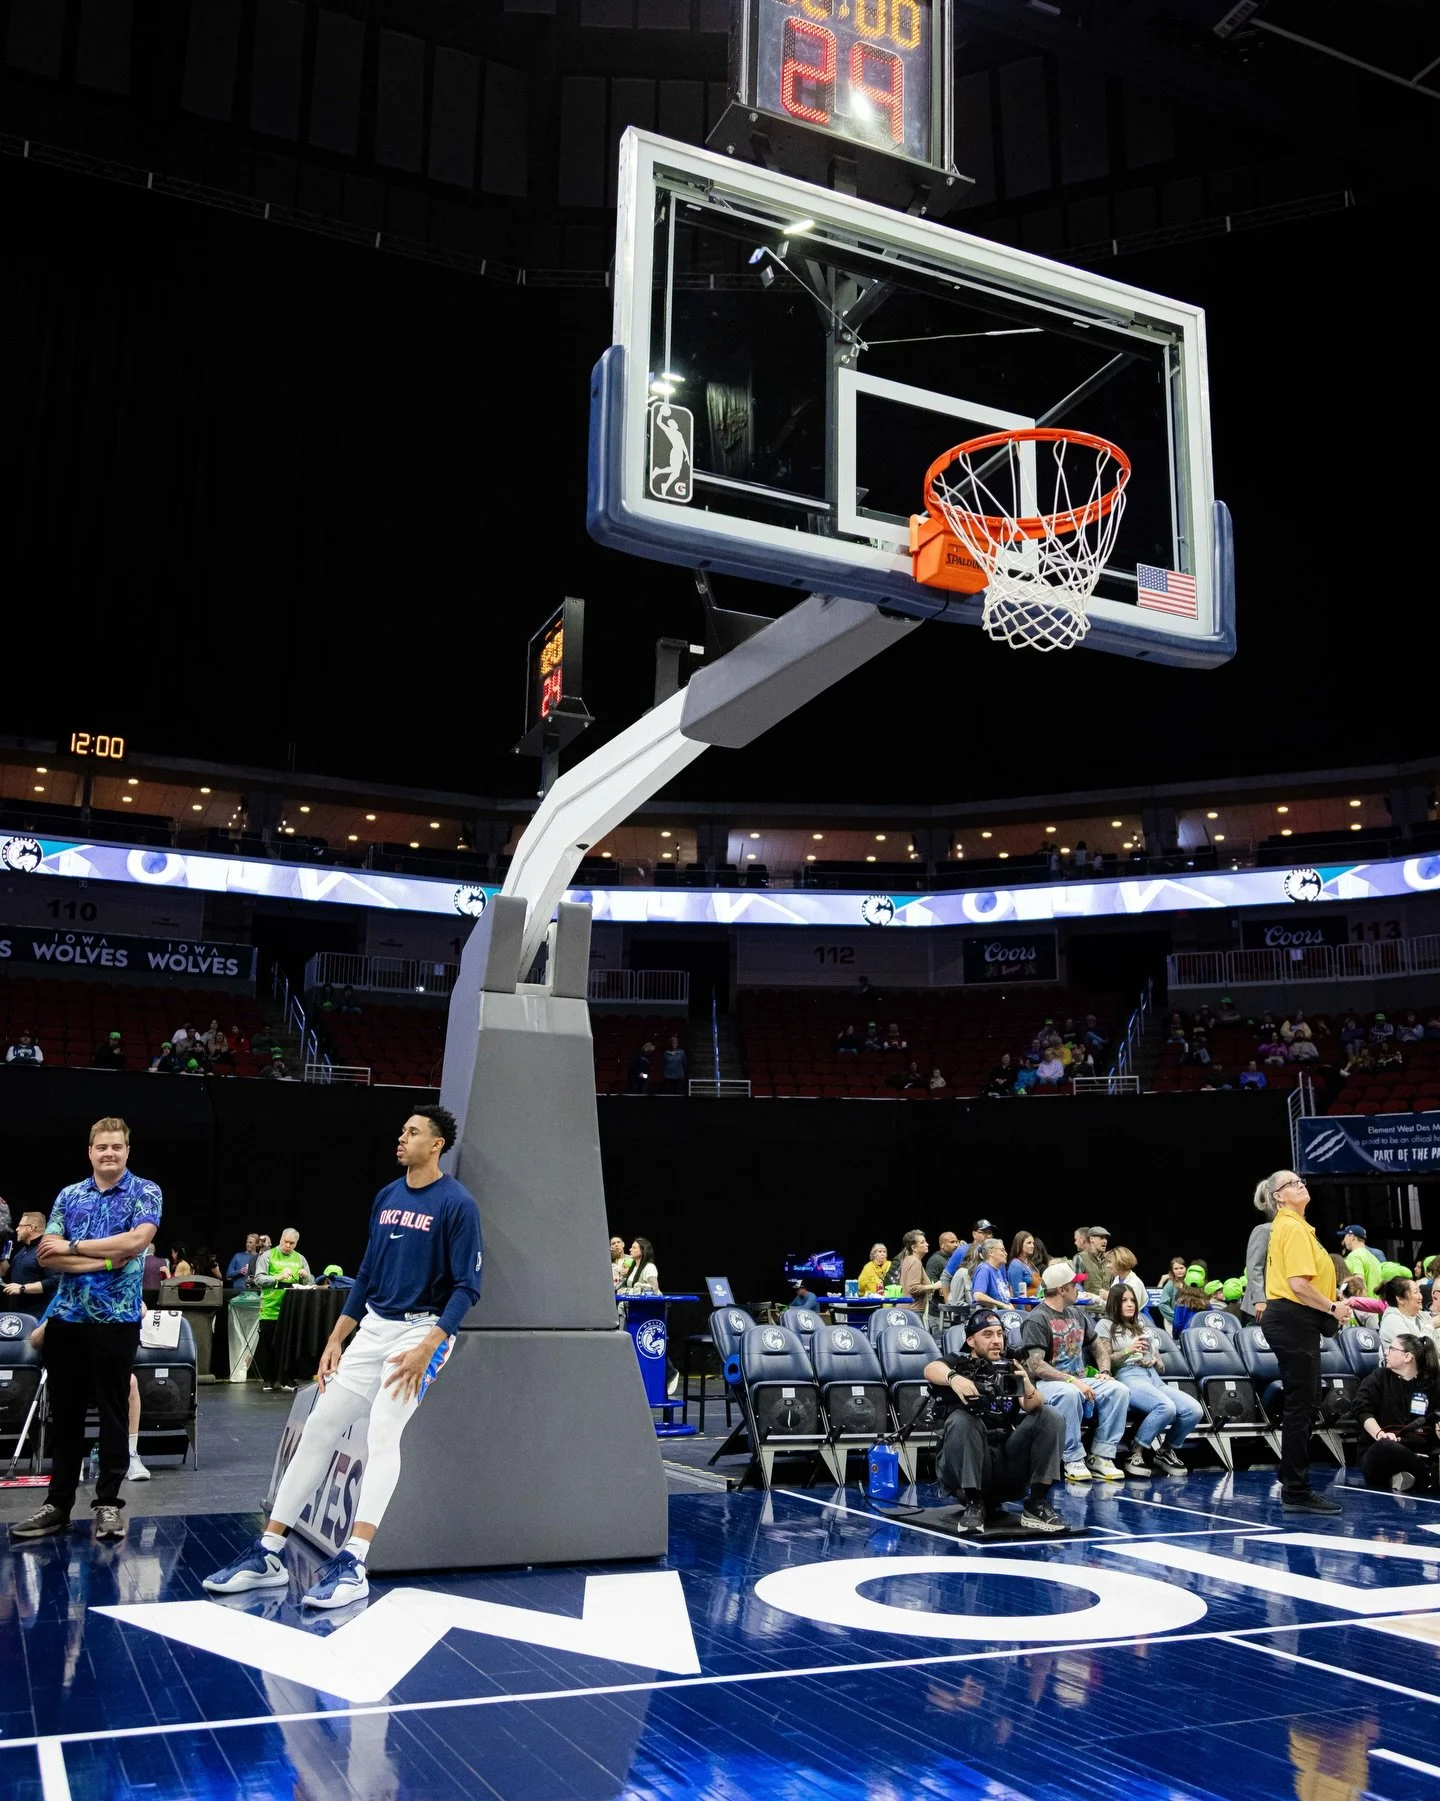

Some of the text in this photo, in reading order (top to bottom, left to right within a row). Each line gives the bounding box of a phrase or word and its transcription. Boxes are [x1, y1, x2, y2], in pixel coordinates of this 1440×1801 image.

[781, 16, 904, 144] 24
[674, 482, 686, 496] G
[945, 553, 983, 571] SPALDIN
[70, 733, 124, 759] 12:00
[48, 899, 97, 922] 110
[54, 933, 107, 946] IOWA
[1264, 925, 1324, 946] Coors
[32, 942, 128, 968] WOLVES
[168, 943, 218, 956] IOWA
[814, 946, 855, 964] 112
[984, 942, 1037, 962] Coors
[147, 952, 239, 976] WOLVES
[1373, 1149, 1394, 1163] PART
[1397, 1149, 1409, 1162] OF
[1411, 1147, 1429, 1161] THE
[379, 1209, 434, 1232] OKC BLUE
